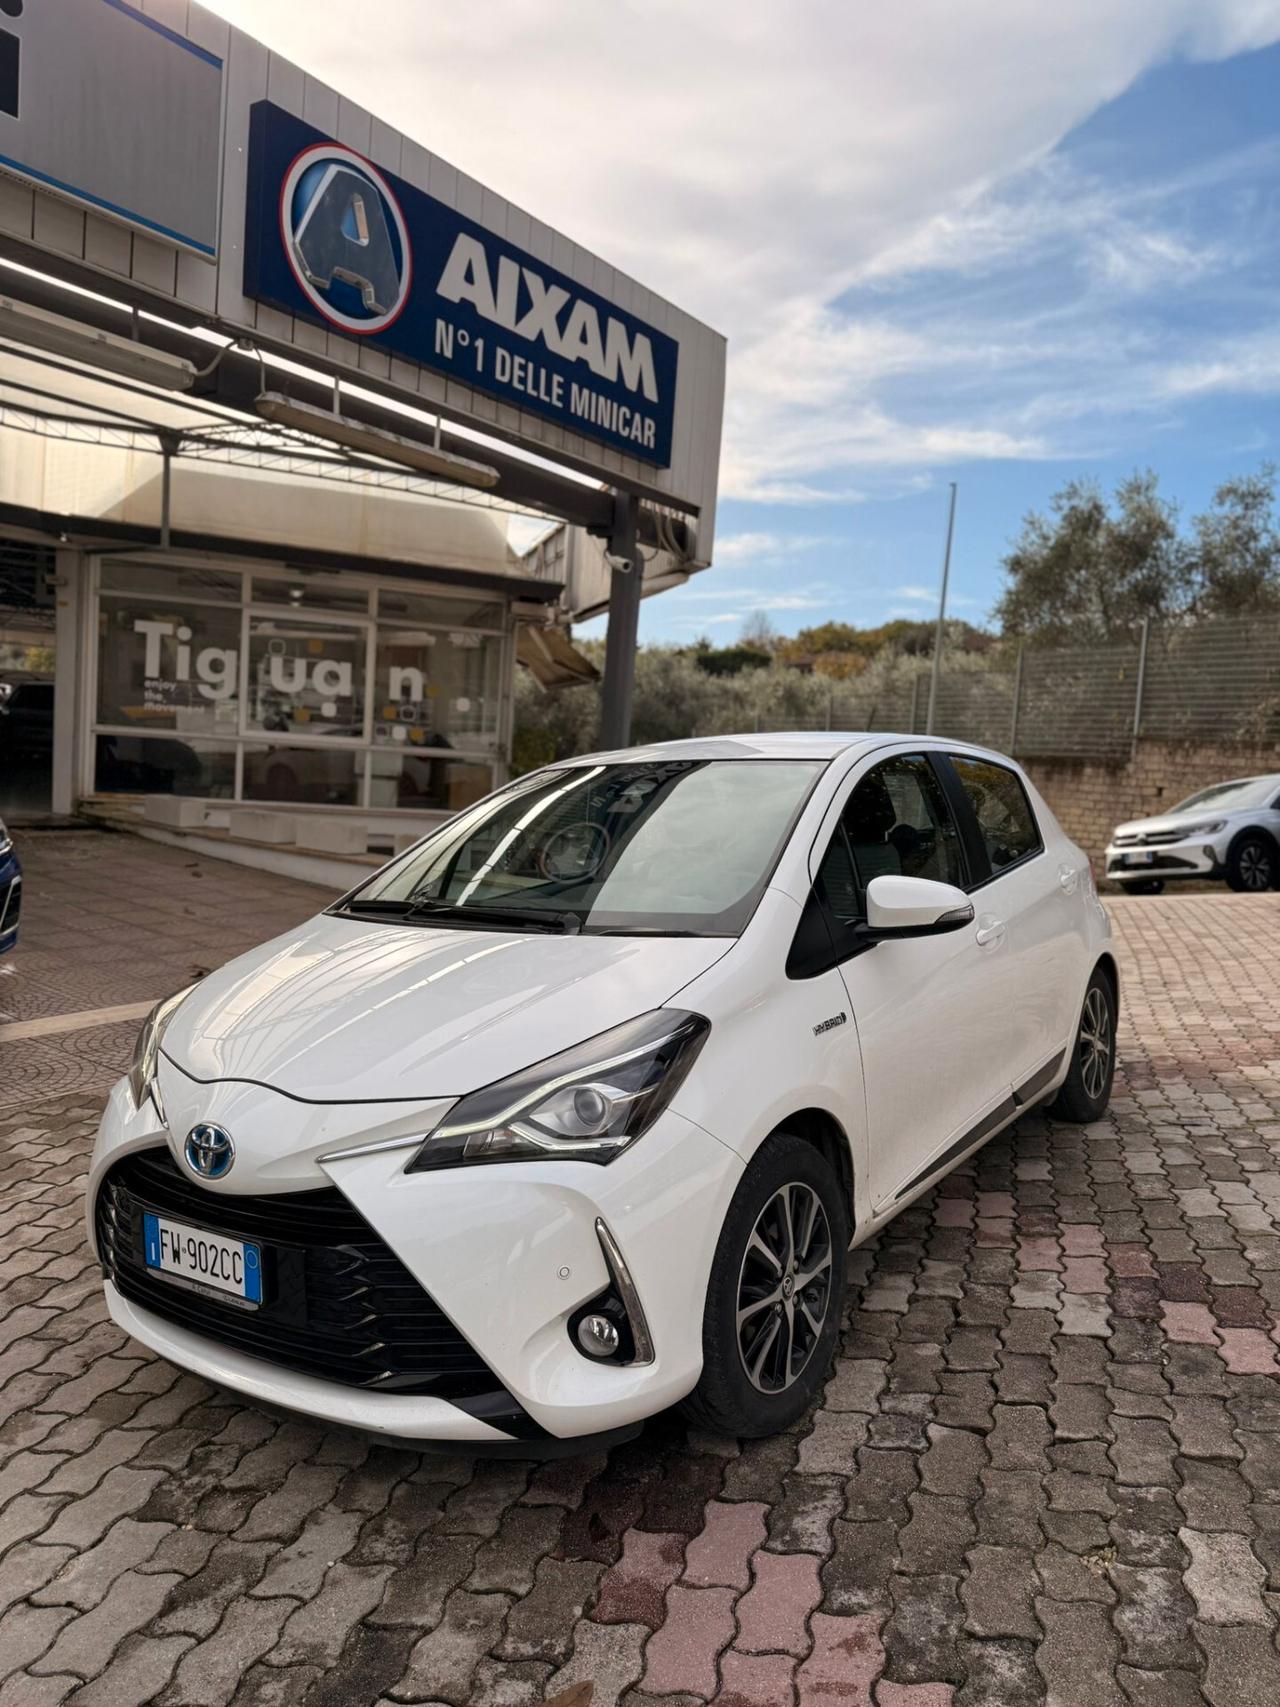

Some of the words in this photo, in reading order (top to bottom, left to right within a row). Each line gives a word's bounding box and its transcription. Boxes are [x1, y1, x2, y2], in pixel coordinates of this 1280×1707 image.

[436, 231, 659, 404] AIXAM
[495, 345, 565, 409] DELLE
[570, 382, 657, 449] MINICAR
[144, 678, 177, 692] enjoy
[812, 1014, 845, 1037] HYBRID
